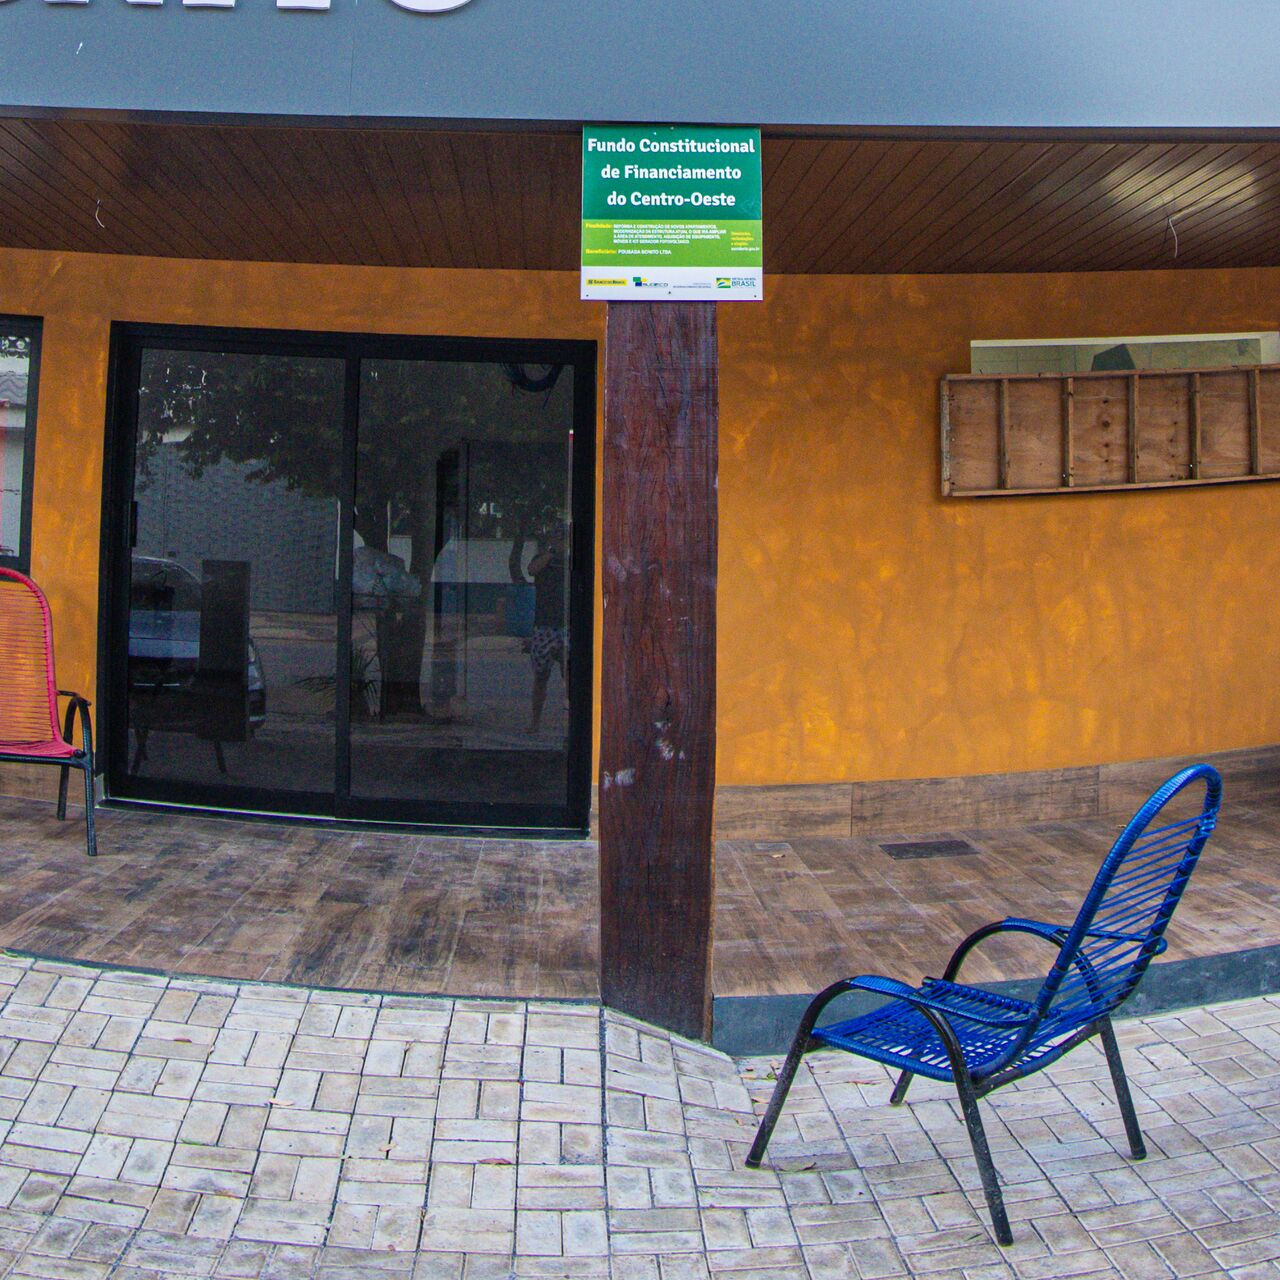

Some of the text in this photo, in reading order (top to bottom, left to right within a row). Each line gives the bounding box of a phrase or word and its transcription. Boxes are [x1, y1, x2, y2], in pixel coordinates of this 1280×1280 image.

[587, 138, 755, 153] Fundo Constitucional
[601, 164, 742, 180] de Financiamento
[607, 191, 736, 207] do Centro-Oeste
